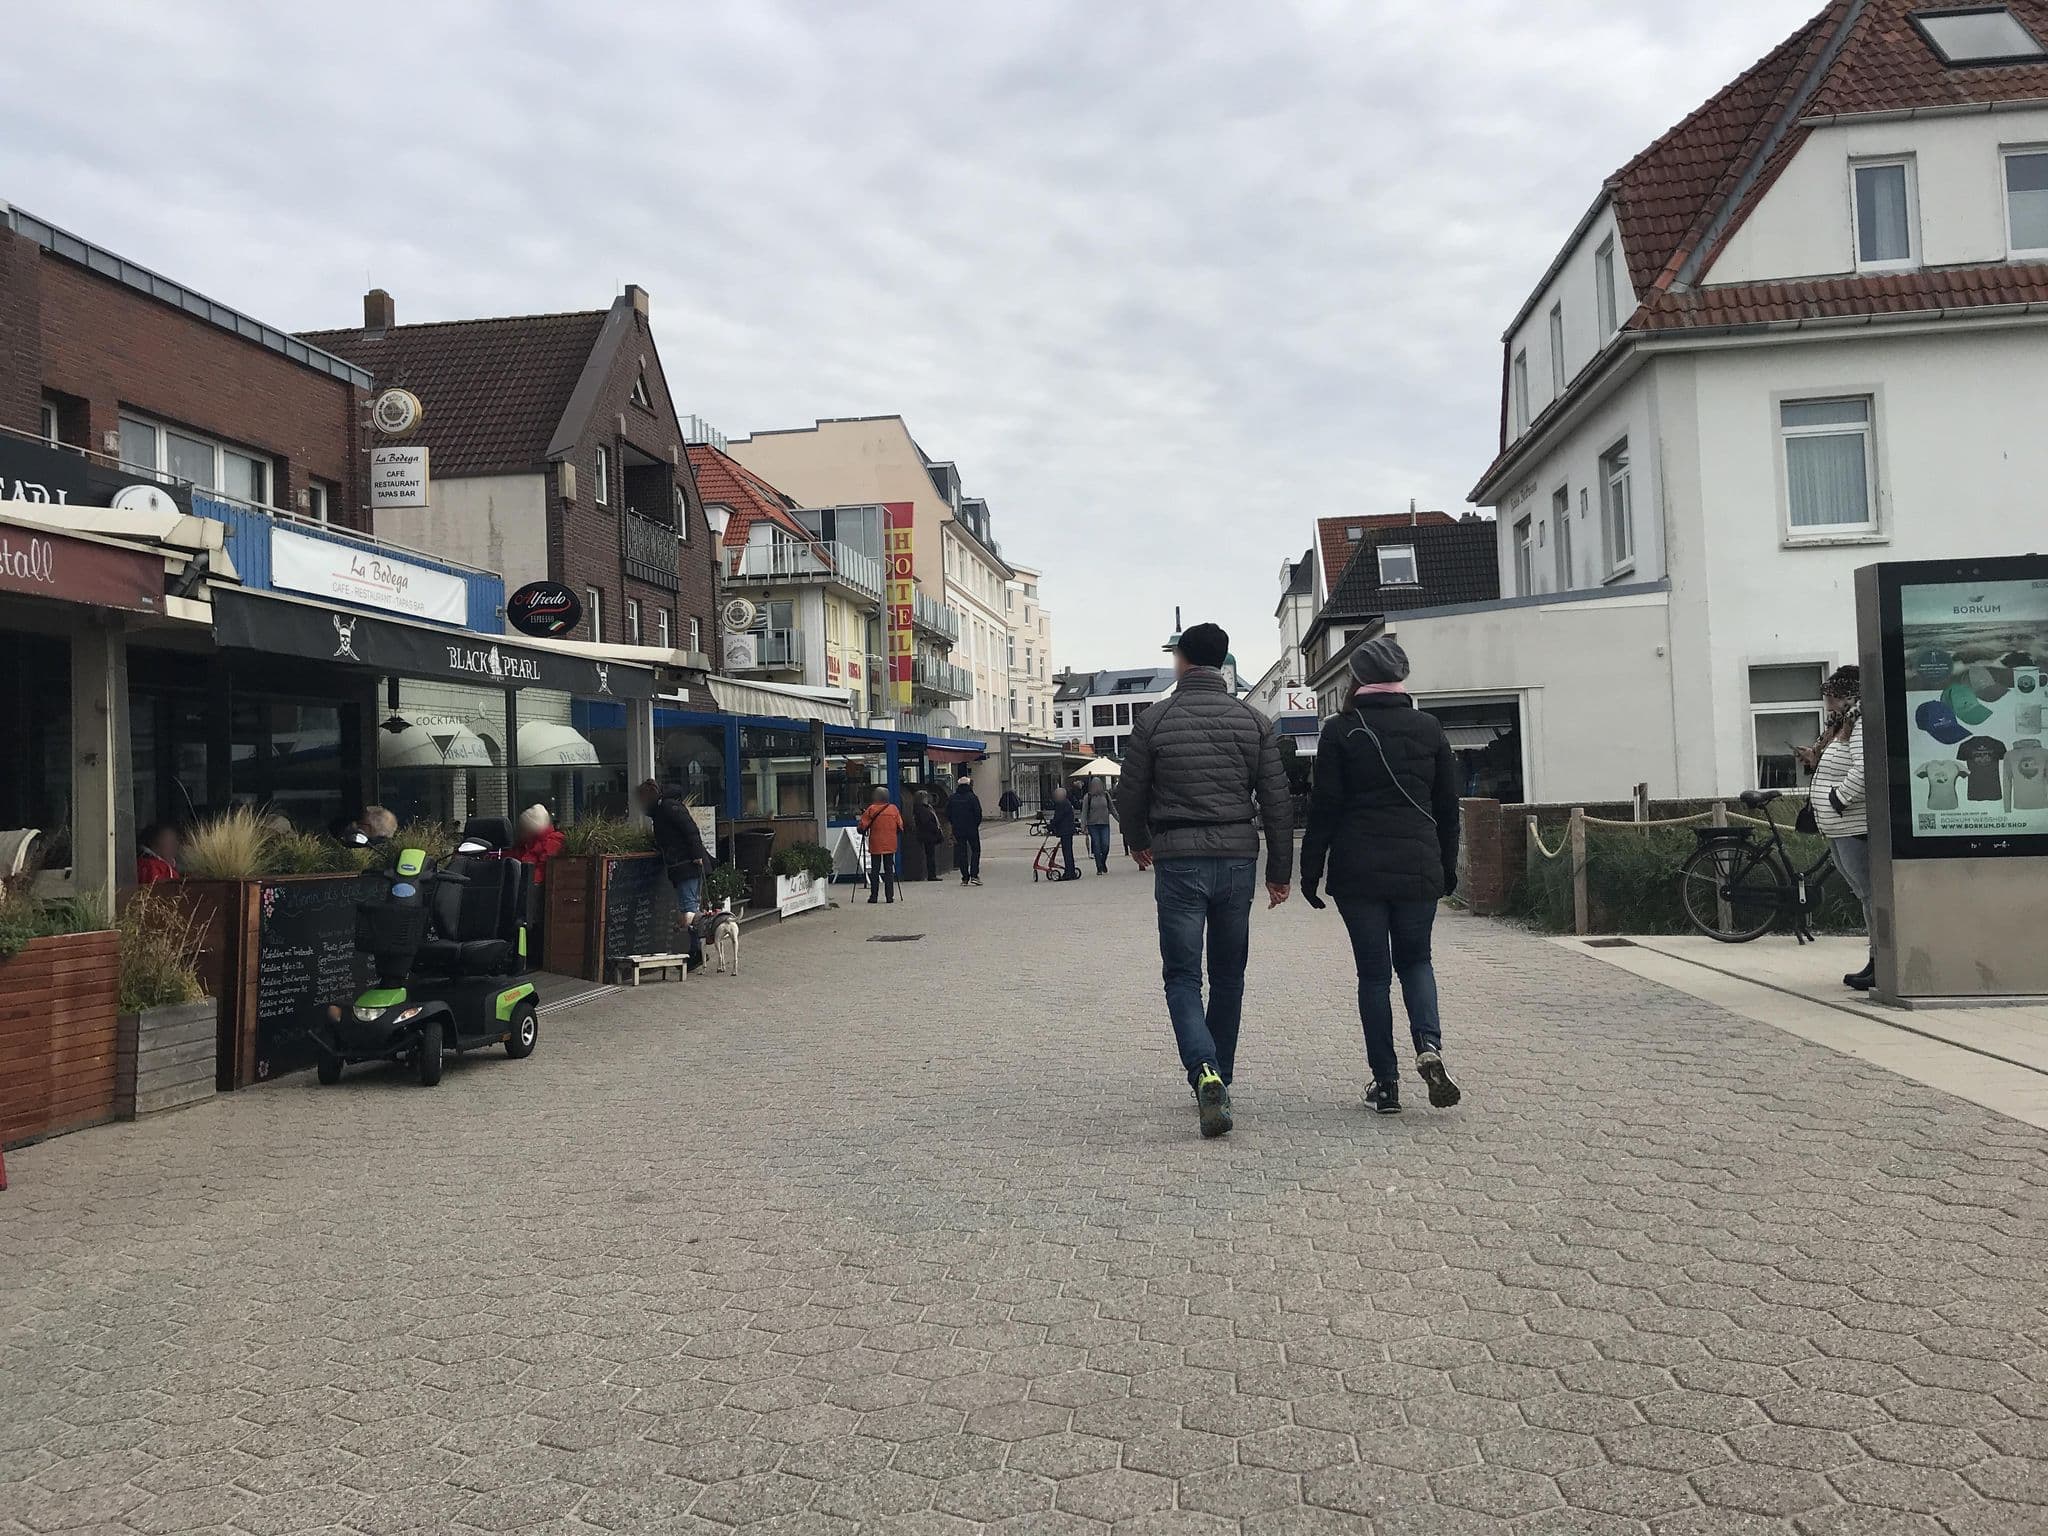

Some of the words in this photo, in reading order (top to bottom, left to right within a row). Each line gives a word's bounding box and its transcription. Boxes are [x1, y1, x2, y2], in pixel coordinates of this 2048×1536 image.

[375, 454, 386, 462] La
[387, 453, 419, 464] Bodega
[374, 480, 420, 488] RESTAURANT
[350, 555, 366, 578] La
[369, 561, 409, 593] Bodega
[354, 585, 393, 603] RESTAURANT
[514, 591, 567, 609] Alfredo
[894, 532, 911, 651] HOTEL
[1953, 604, 2001, 614] BORKUM
[446, 646, 489, 674] BLACK
[501, 655, 541, 680] PEARL
[415, 714, 471, 726] COCKTAILS
